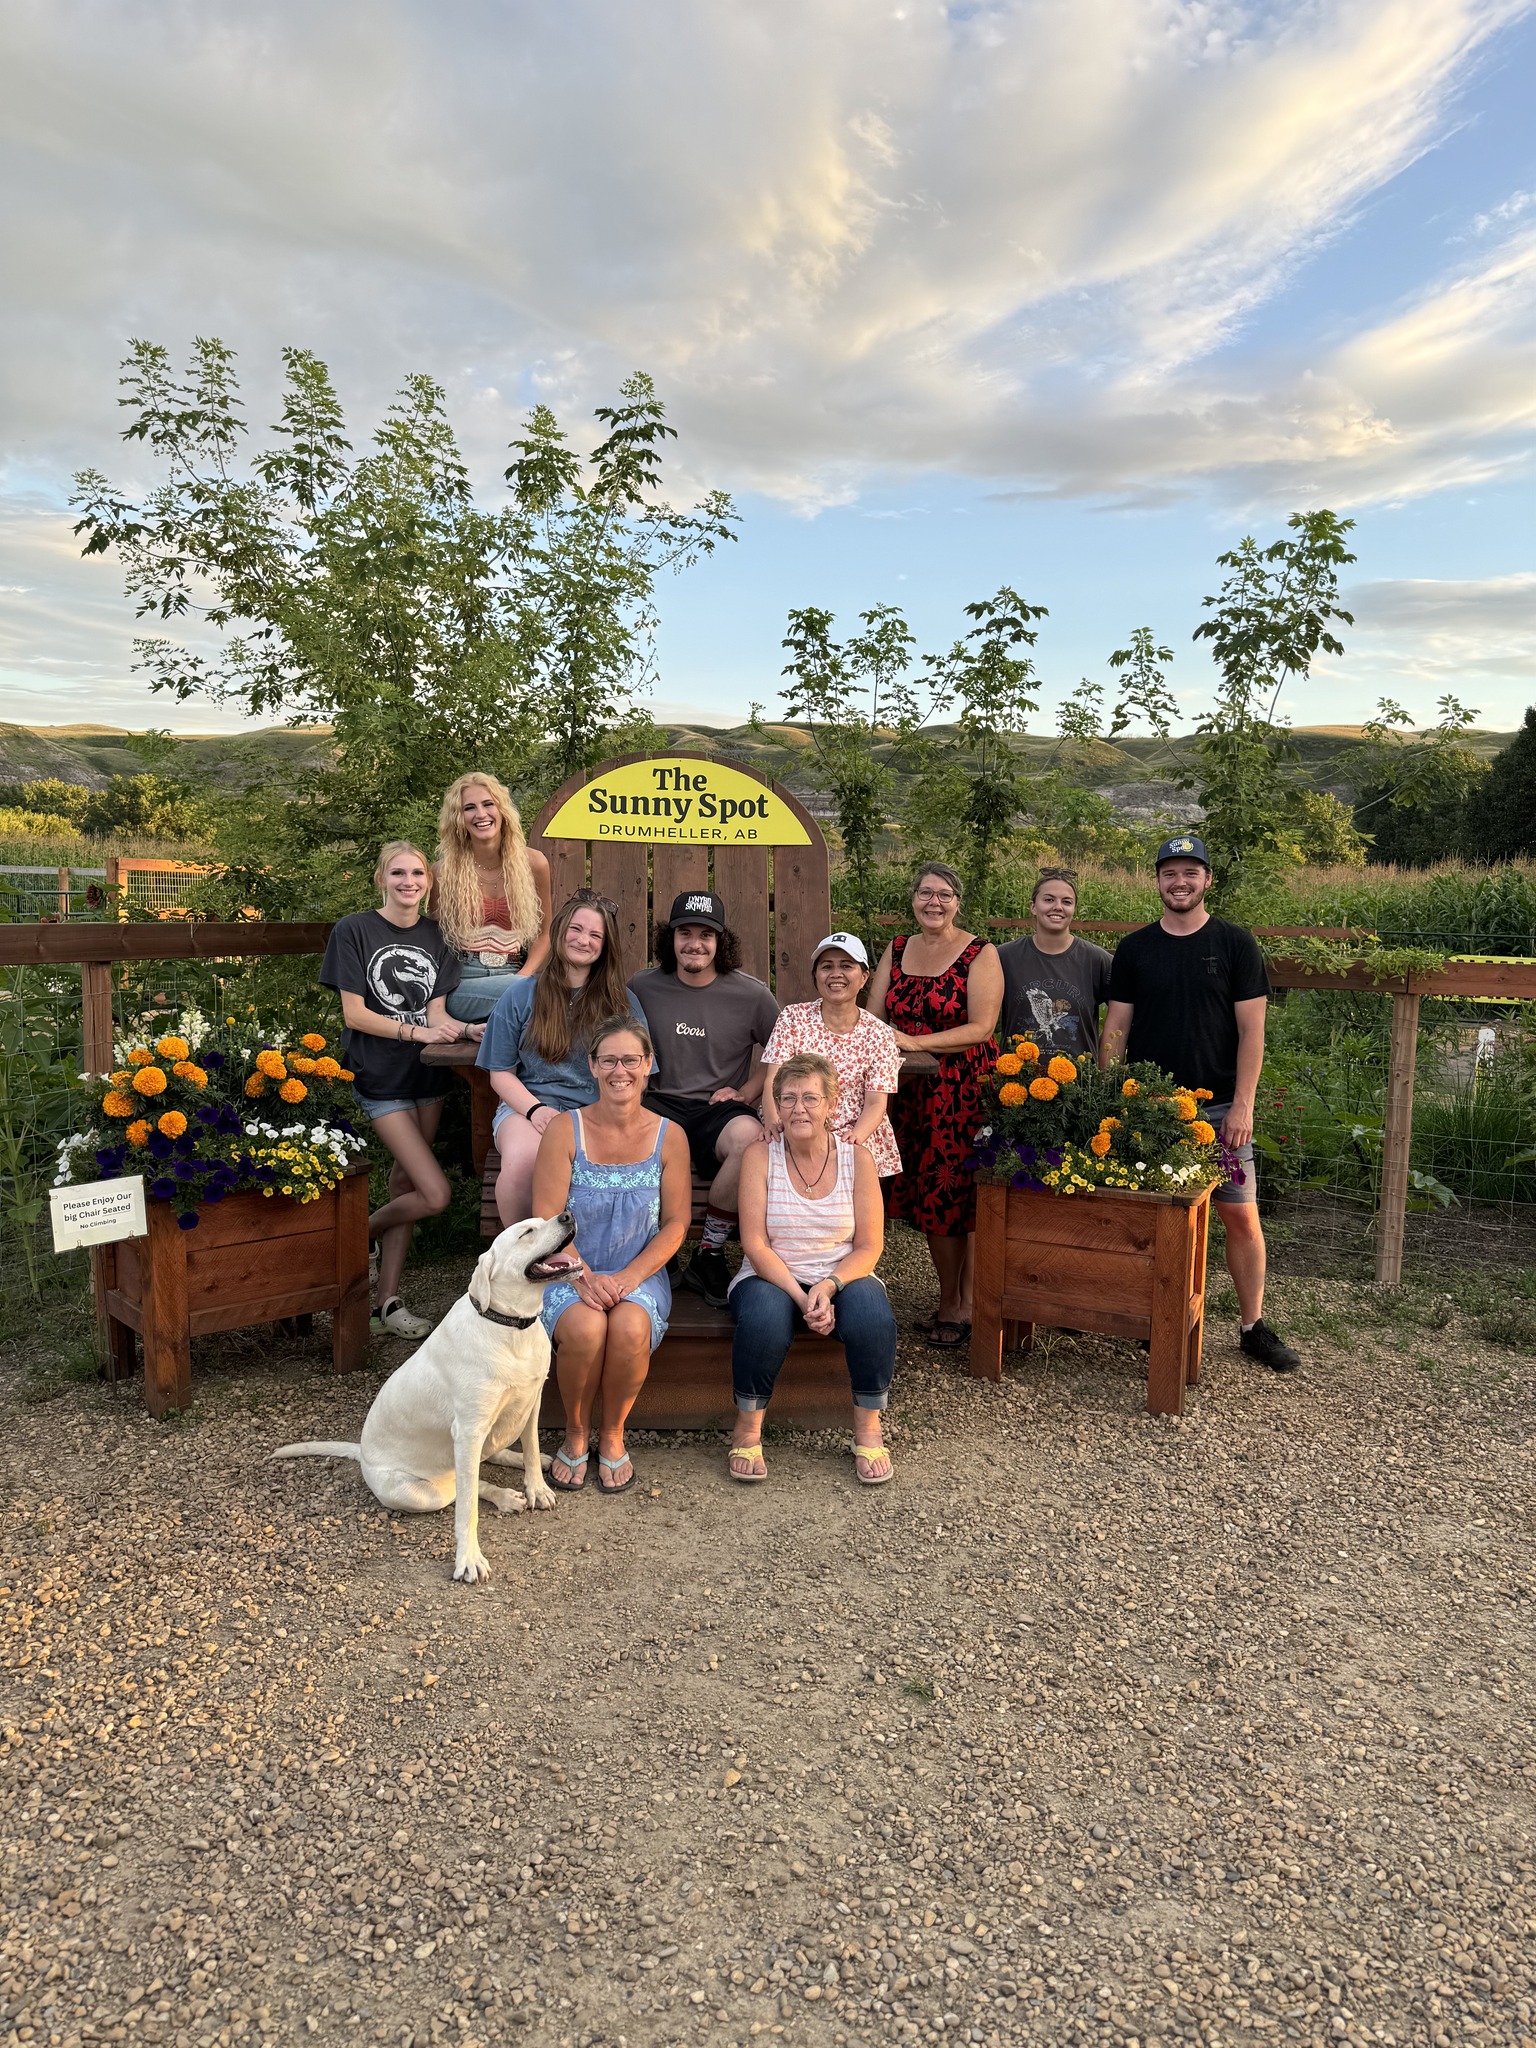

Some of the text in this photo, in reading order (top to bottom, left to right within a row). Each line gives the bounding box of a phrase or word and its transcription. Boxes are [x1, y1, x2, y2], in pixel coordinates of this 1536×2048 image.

[652, 767, 707, 791] The
[588, 788, 769, 824] Sunny Spot
[599, 824, 758, 841] DRUMHELLER, AB
[676, 1022, 705, 1037] Coors
[63, 1200, 91, 1211] Please
[92, 1196, 115, 1206] Enjoy
[64, 1203, 131, 1222] big Chair Seated
[89, 1218, 117, 1228] Climbing
